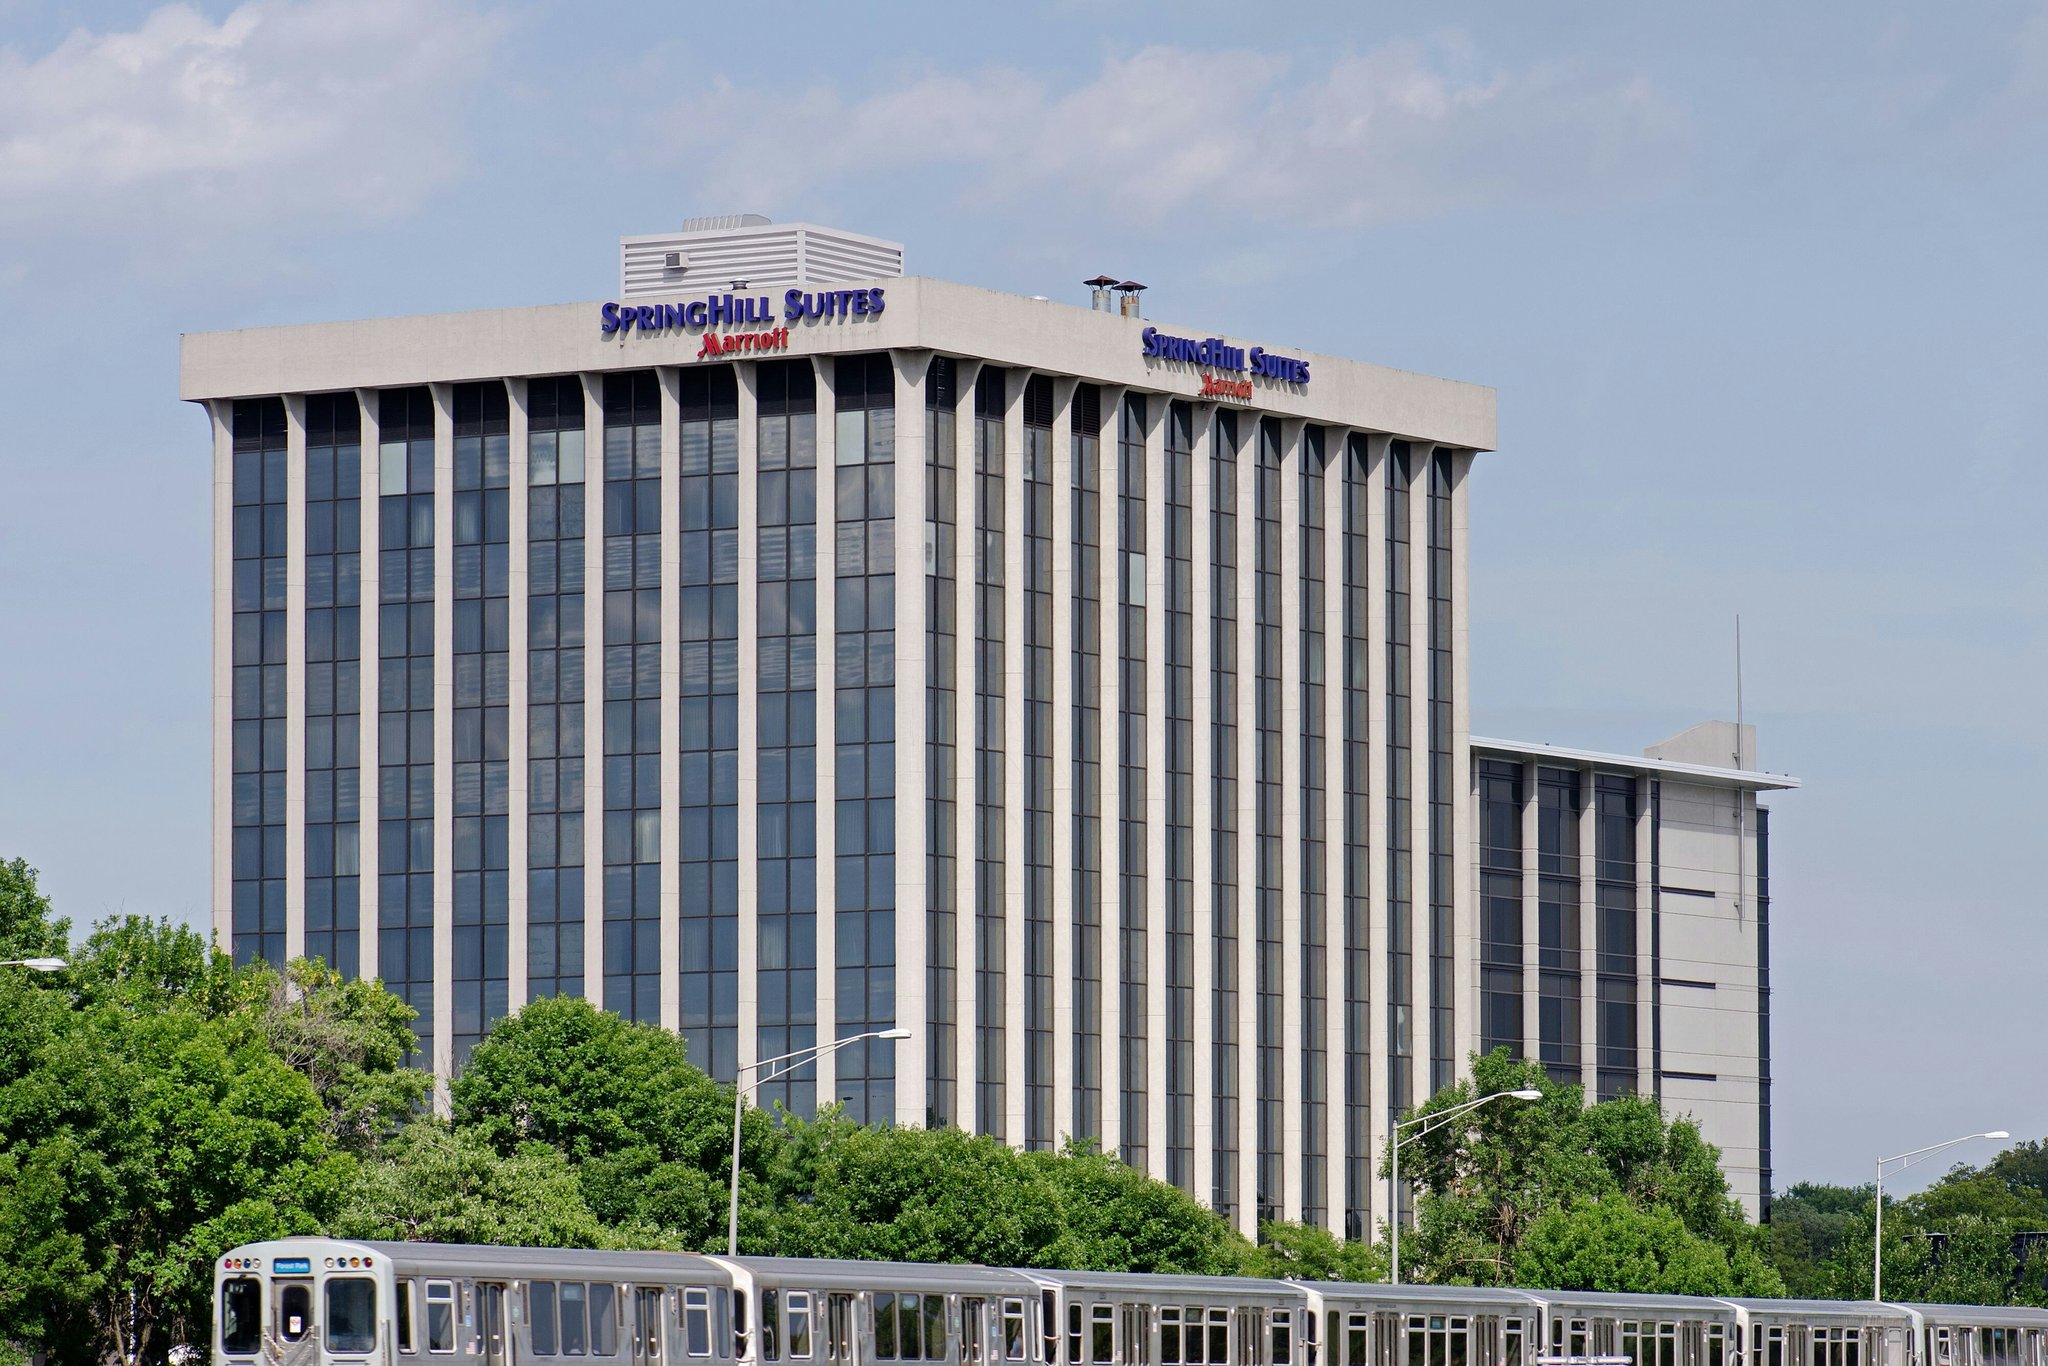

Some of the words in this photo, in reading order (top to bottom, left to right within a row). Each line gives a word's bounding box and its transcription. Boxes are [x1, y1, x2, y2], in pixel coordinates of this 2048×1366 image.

[601, 294, 775, 333] SPRINGHILL
[784, 288, 885, 320] SUITES
[698, 326, 789, 357] Marriott
[1250, 346, 1310, 384] SUITES
[1198, 372, 1252, 399] Marriott
